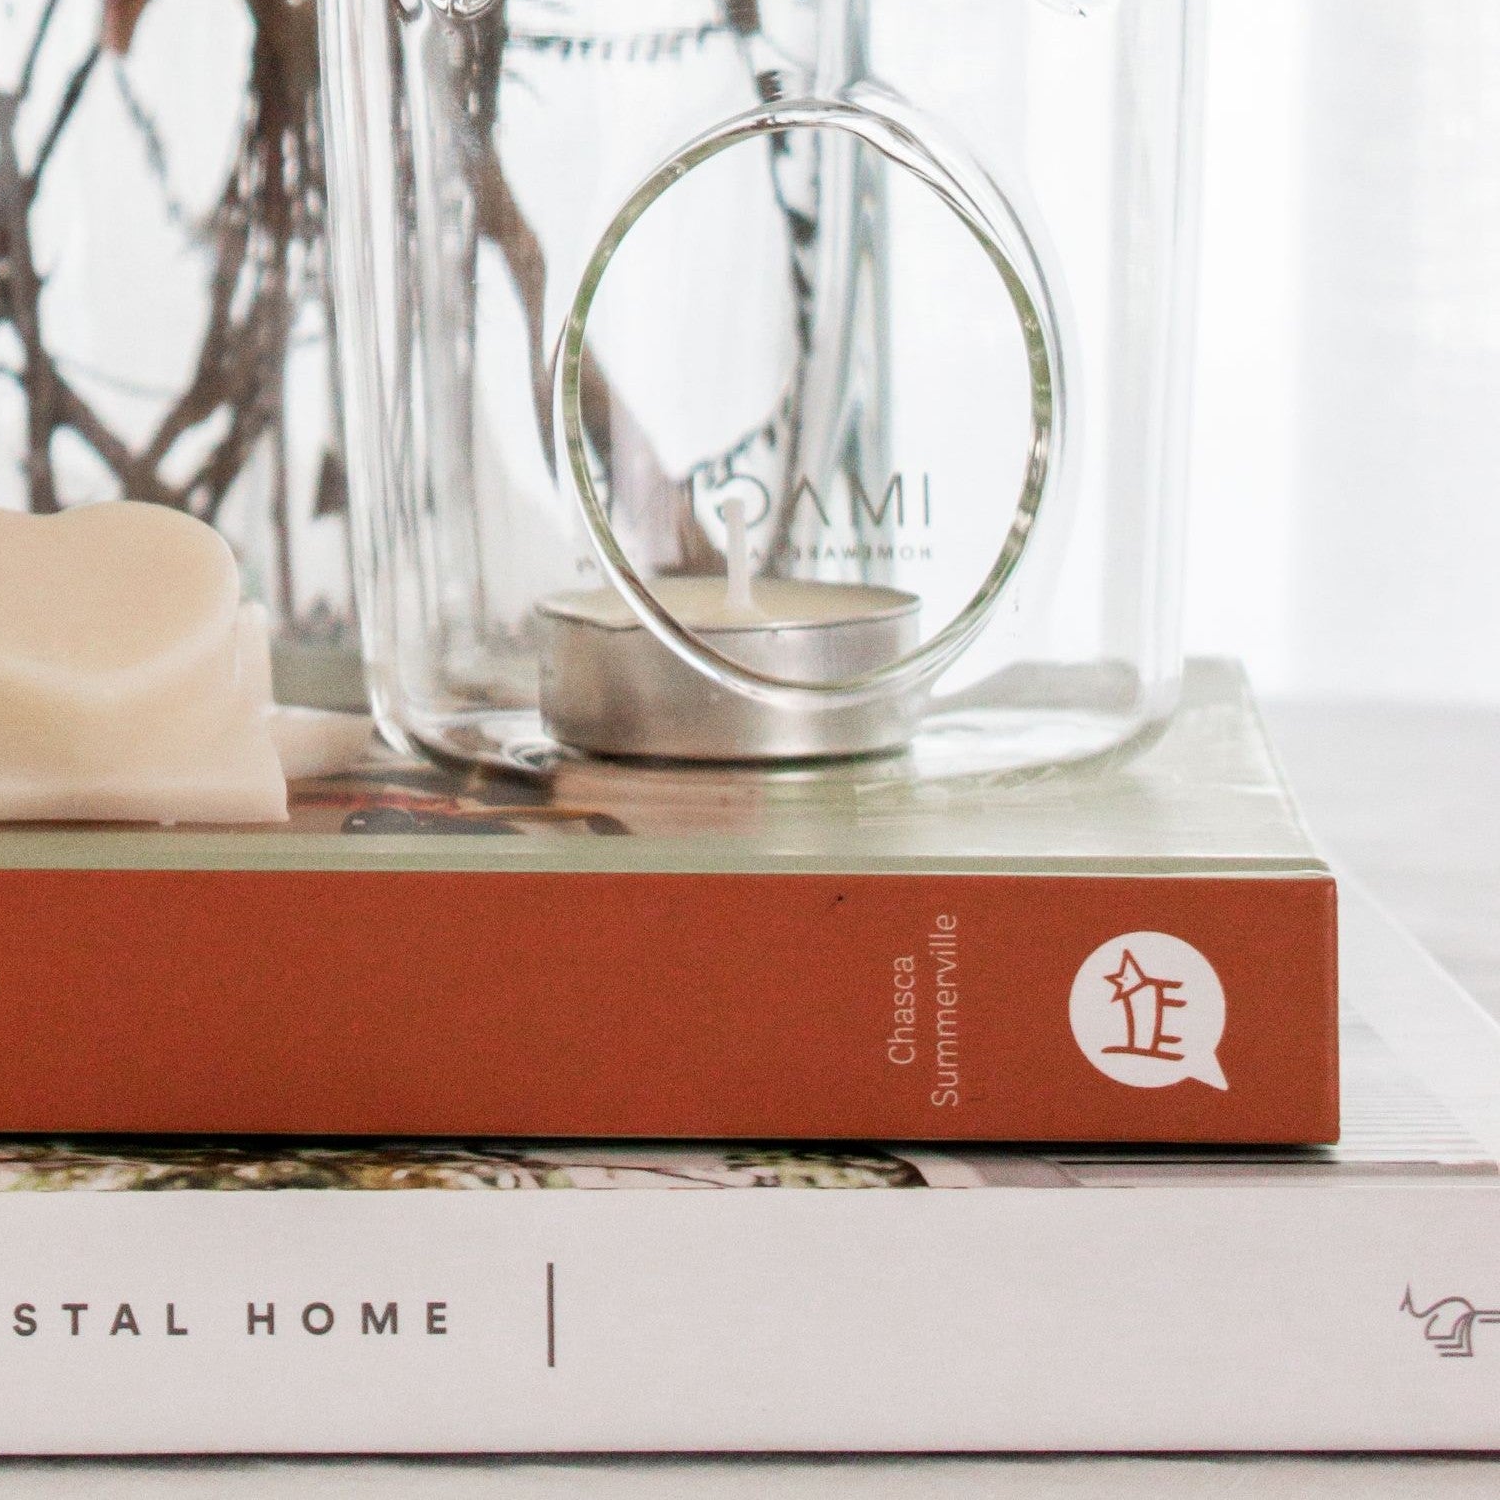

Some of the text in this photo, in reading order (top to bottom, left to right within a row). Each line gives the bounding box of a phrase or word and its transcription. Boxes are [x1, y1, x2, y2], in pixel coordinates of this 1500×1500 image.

[888, 956, 915, 1064] Chasca
[929, 914, 958, 1106] Summerville
[247, 1301, 448, 1336] HOME
